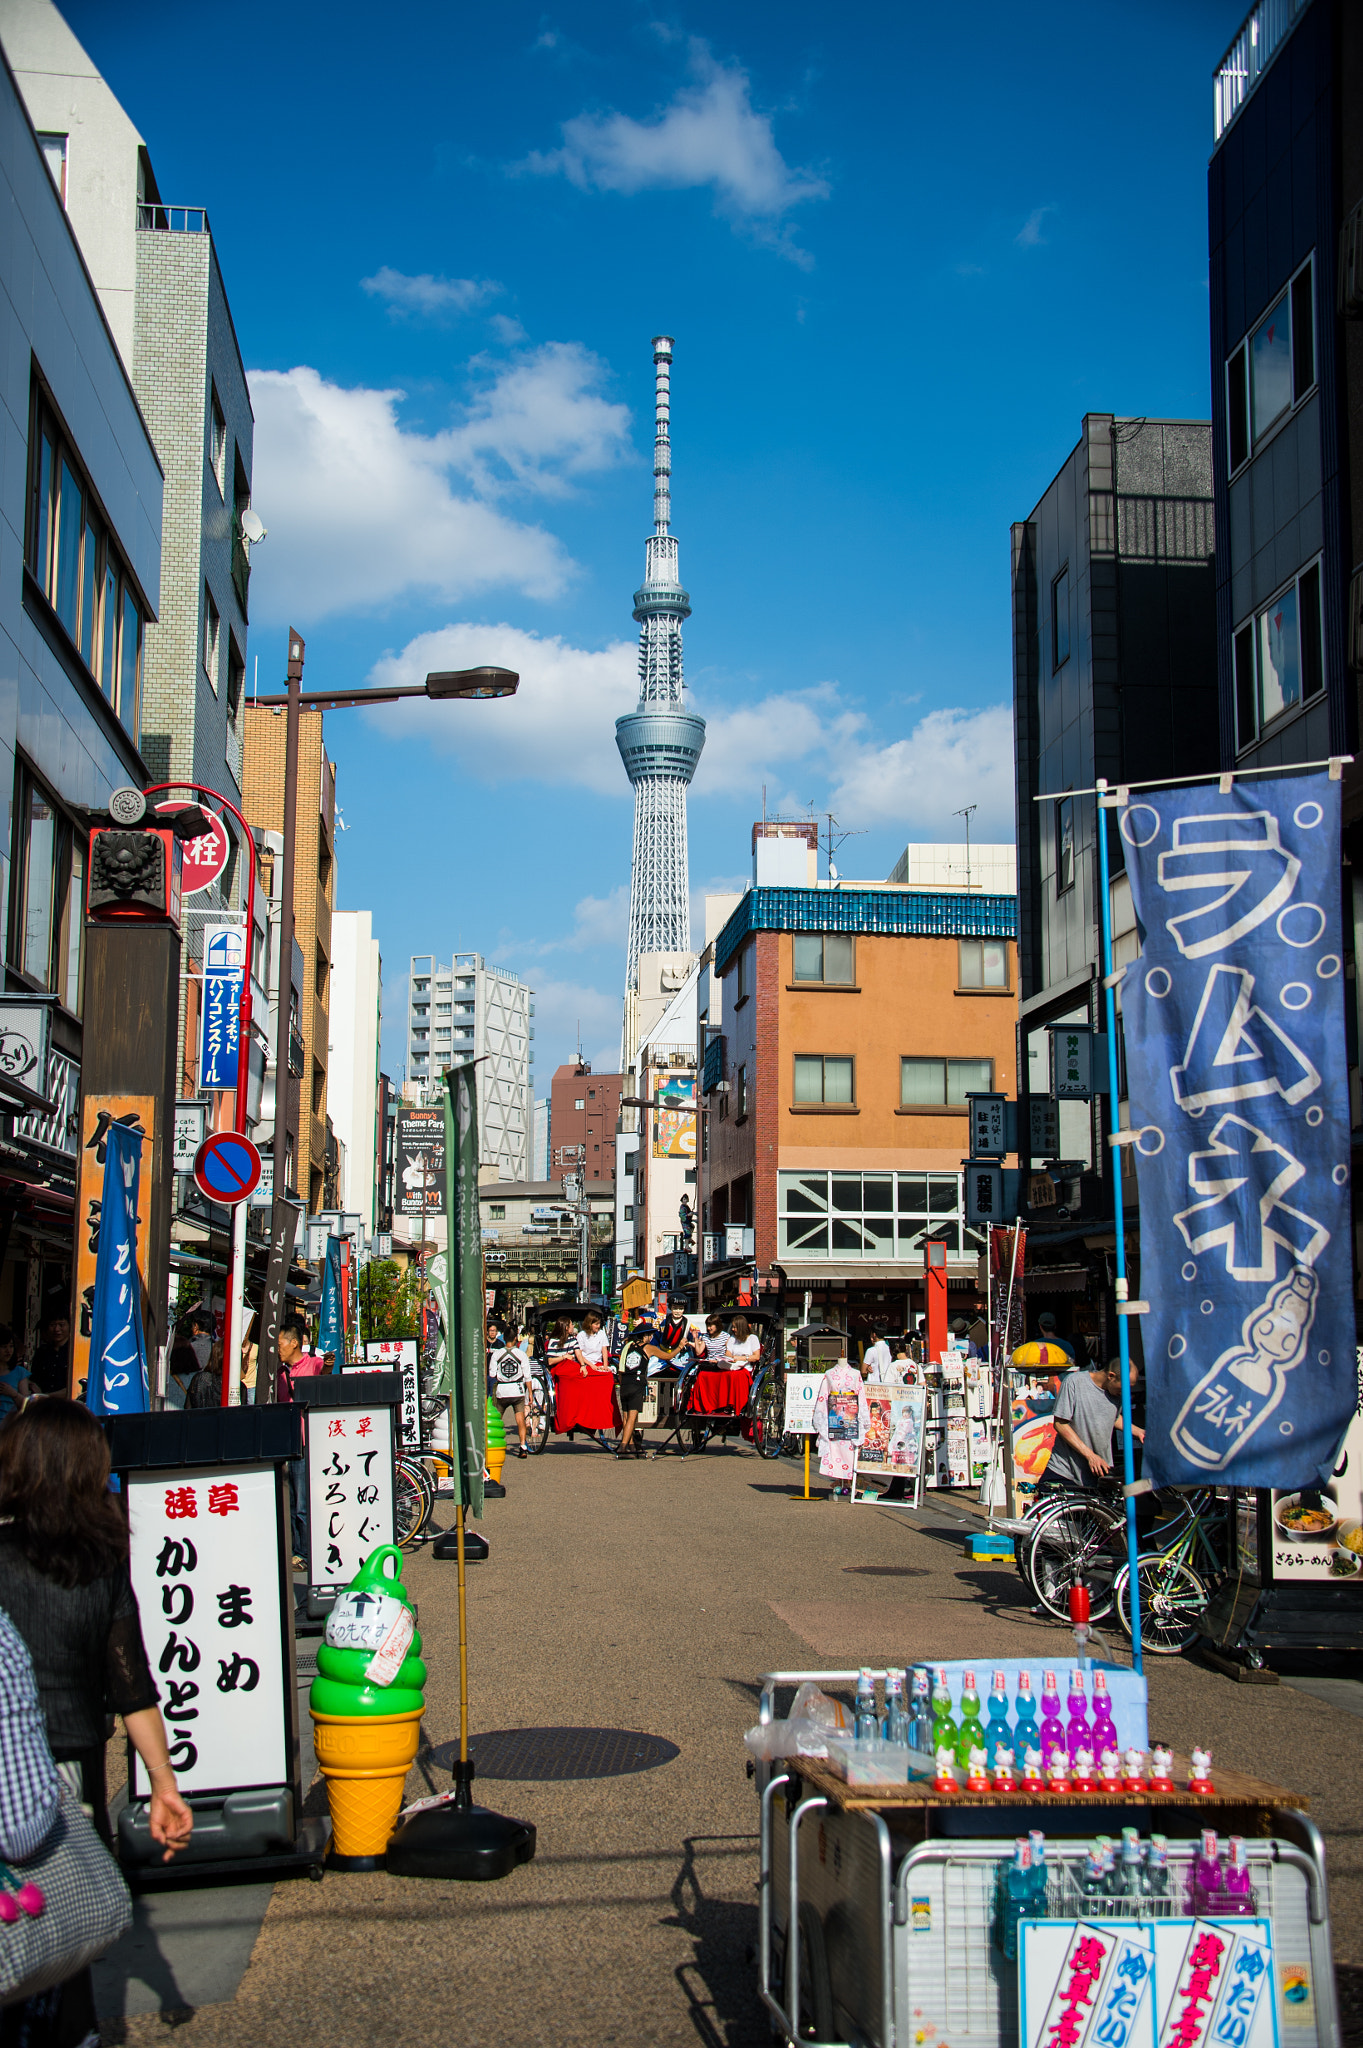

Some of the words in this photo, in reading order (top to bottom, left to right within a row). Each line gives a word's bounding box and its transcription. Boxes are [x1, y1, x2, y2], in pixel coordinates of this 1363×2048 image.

[1066, 1035, 1080, 1082] 神戸の靴
[1158, 810, 1331, 1281] ラムネ
[1059, 1083, 1088, 1092] ヴェニス
[401, 1120, 427, 1128] Theme
[428, 1120, 445, 1129] Park
[410, 1112, 437, 1120] Bunny's
[977, 1111, 989, 1149] 駐車場
[990, 1103, 1002, 1145] 時間貸し
[402, 1198, 423, 1206] Bunny
[406, 1191, 422, 1199] With
[328, 1286, 337, 1333] ガラス細工
[380, 1341, 404, 1353] 浅草
[328, 1416, 374, 1438] 浅草
[1194, 1384, 1251, 1436] ラムネ
[164, 1483, 240, 1520] 浅草
[322, 1452, 350, 1575] ふろしき
[1275, 1552, 1333, 1567] ざるらーめん
[155, 1536, 200, 1773] かりんとう
[216, 1584, 260, 1694] まめ
[1097, 1948, 1148, 2048] 冷たい
[1217, 1945, 1265, 2047] 冷たい
